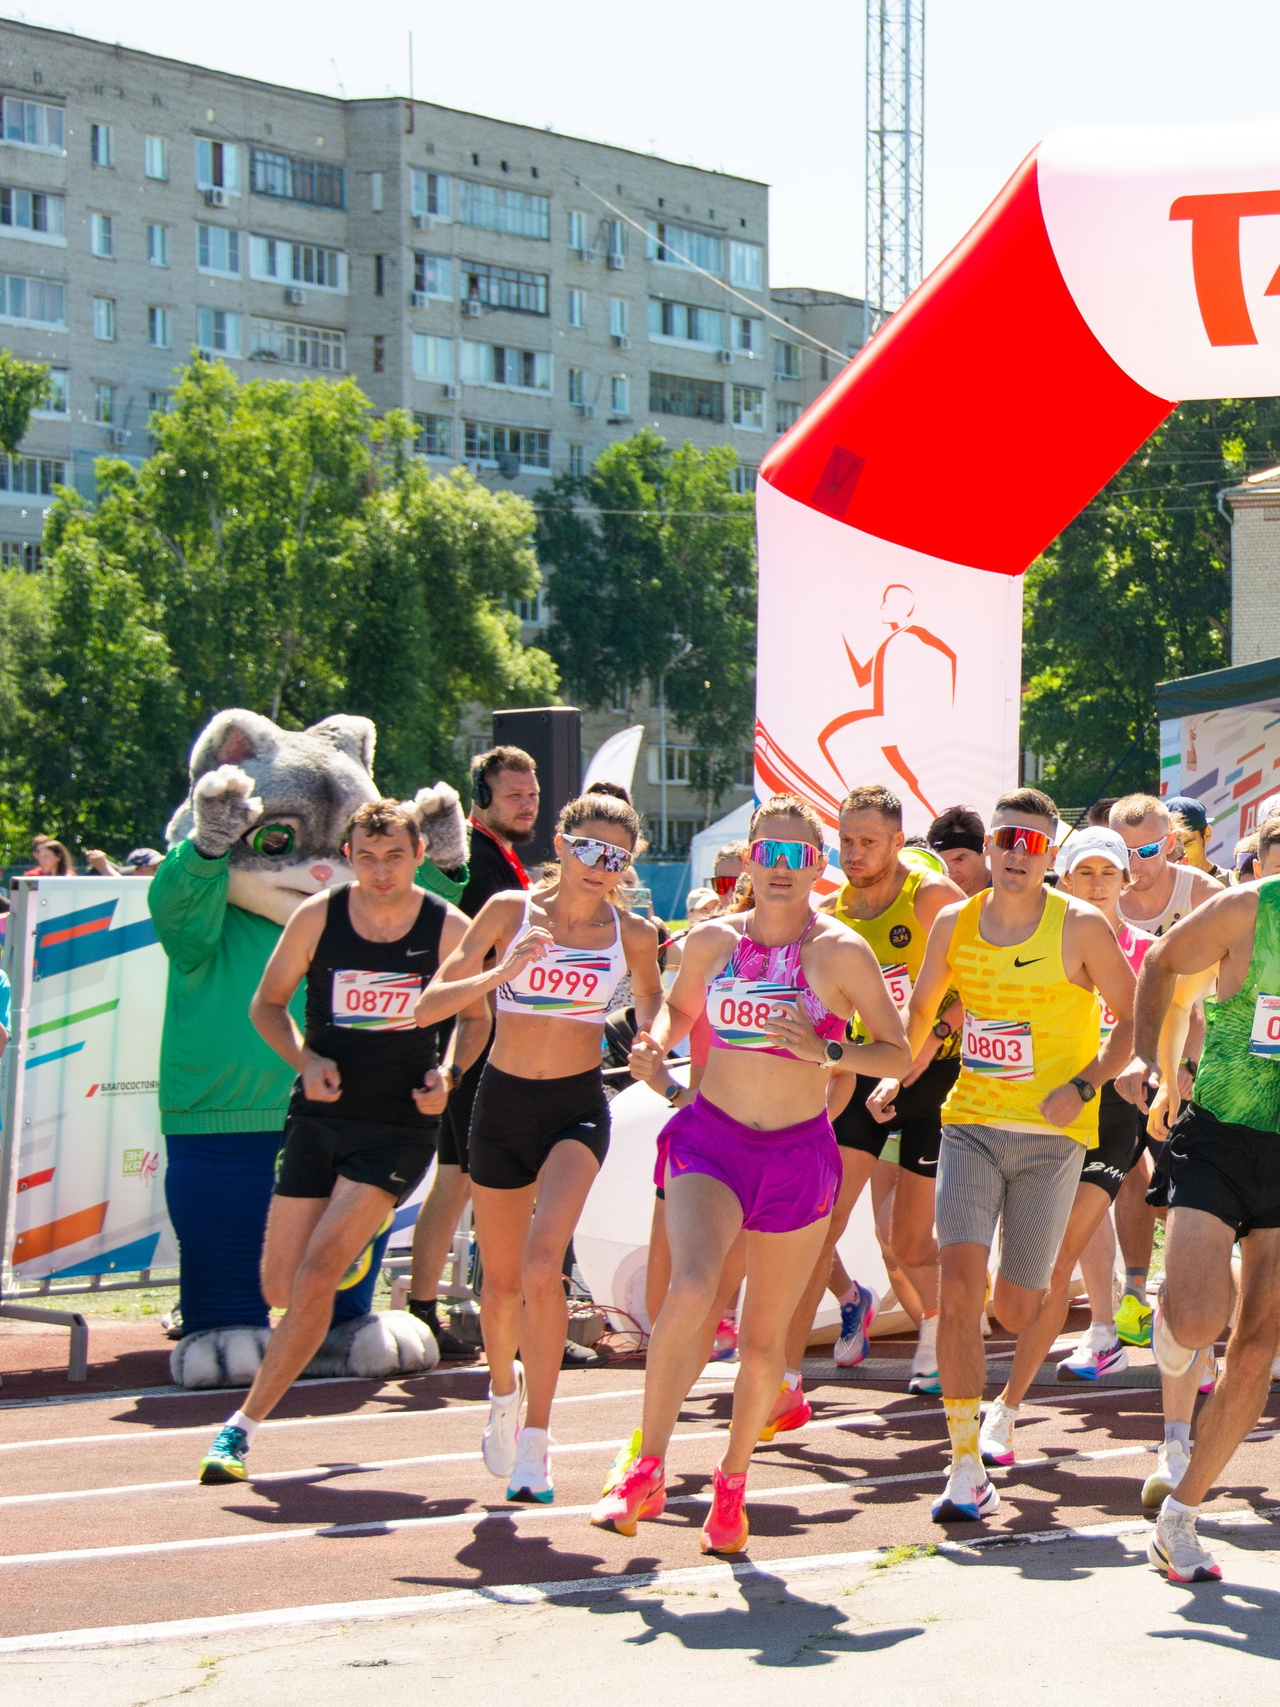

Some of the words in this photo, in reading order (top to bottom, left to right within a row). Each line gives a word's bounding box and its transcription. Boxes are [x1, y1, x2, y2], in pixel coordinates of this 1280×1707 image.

[529, 966, 599, 998] 0999
[345, 989, 411, 1014] 0877
[967, 1032, 1023, 1062] 0803
[101, 1080, 159, 1091] БЛАГОСОСТОЯН
